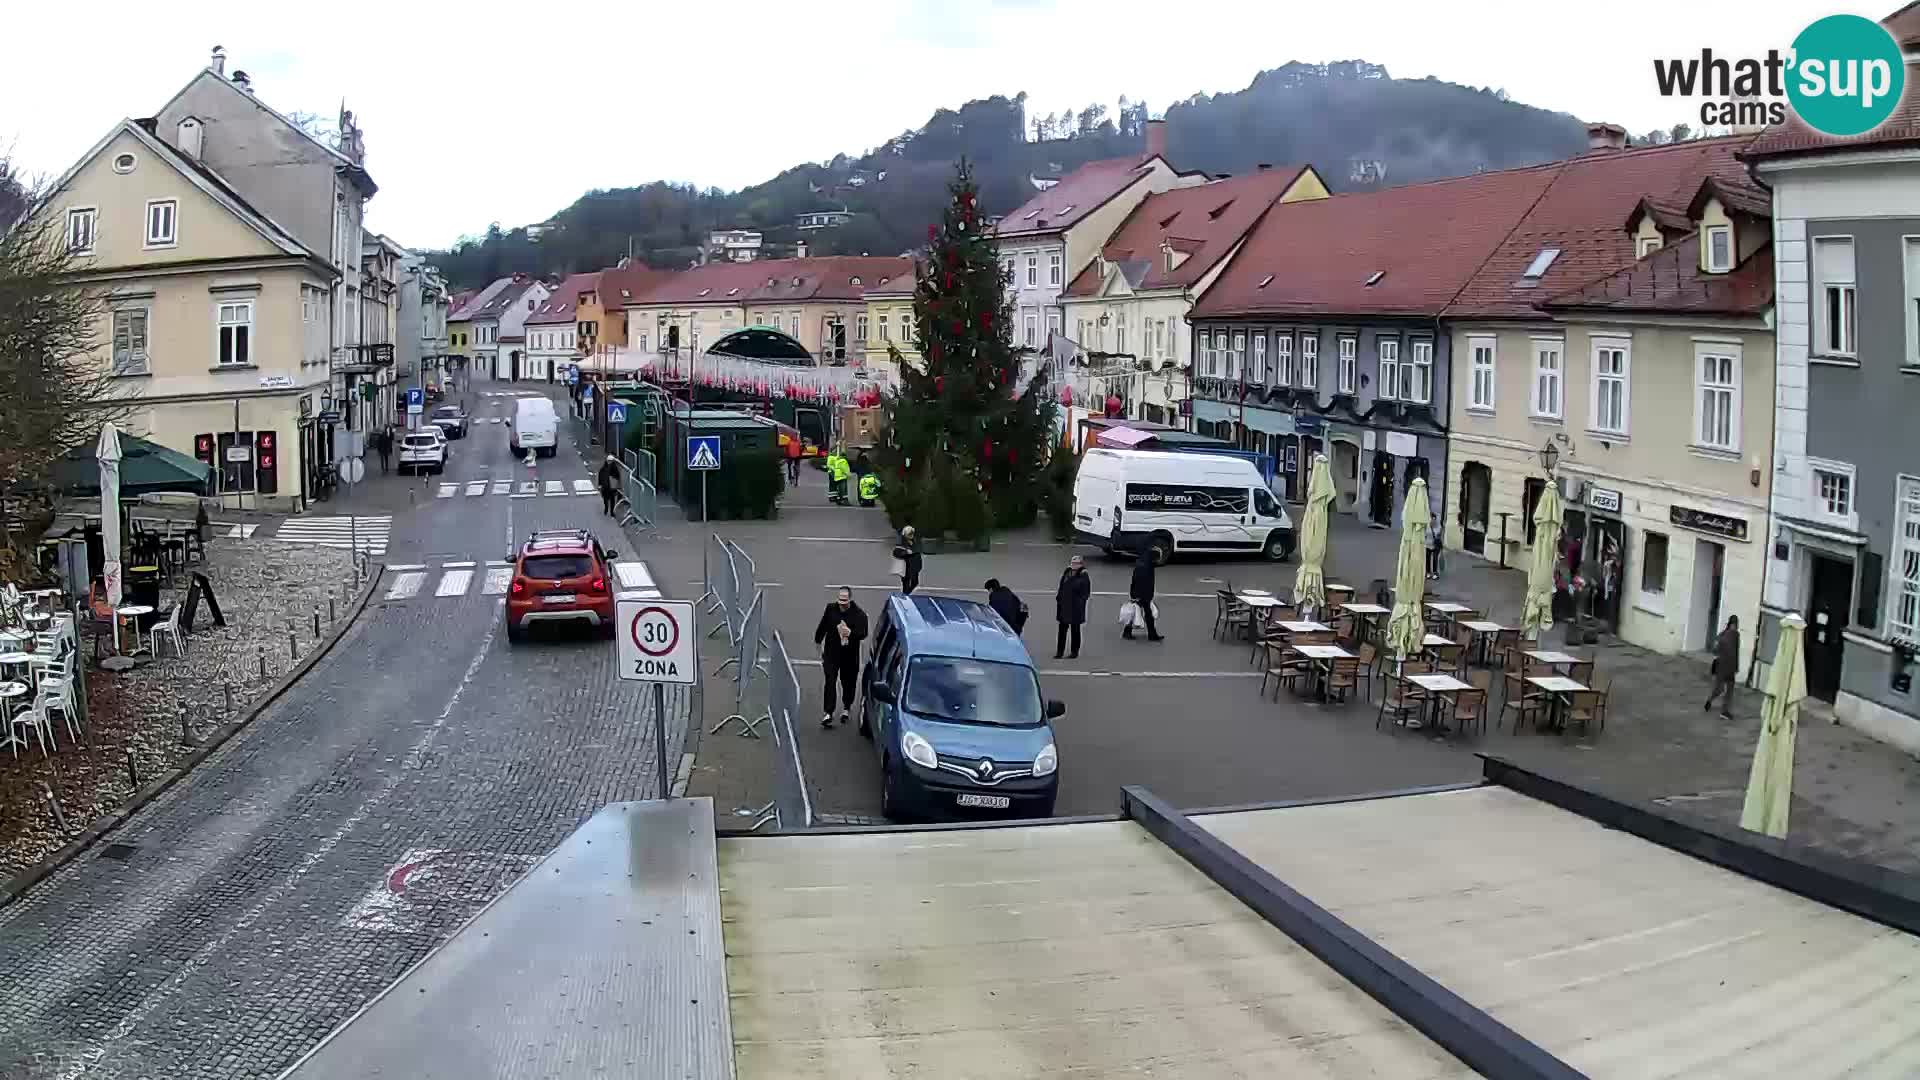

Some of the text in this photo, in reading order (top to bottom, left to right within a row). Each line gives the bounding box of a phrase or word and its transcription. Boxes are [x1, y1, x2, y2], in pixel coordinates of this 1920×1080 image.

[411, 391, 420, 402] P
[644, 622, 668, 644] 30
[634, 659, 679, 677] ZONA
